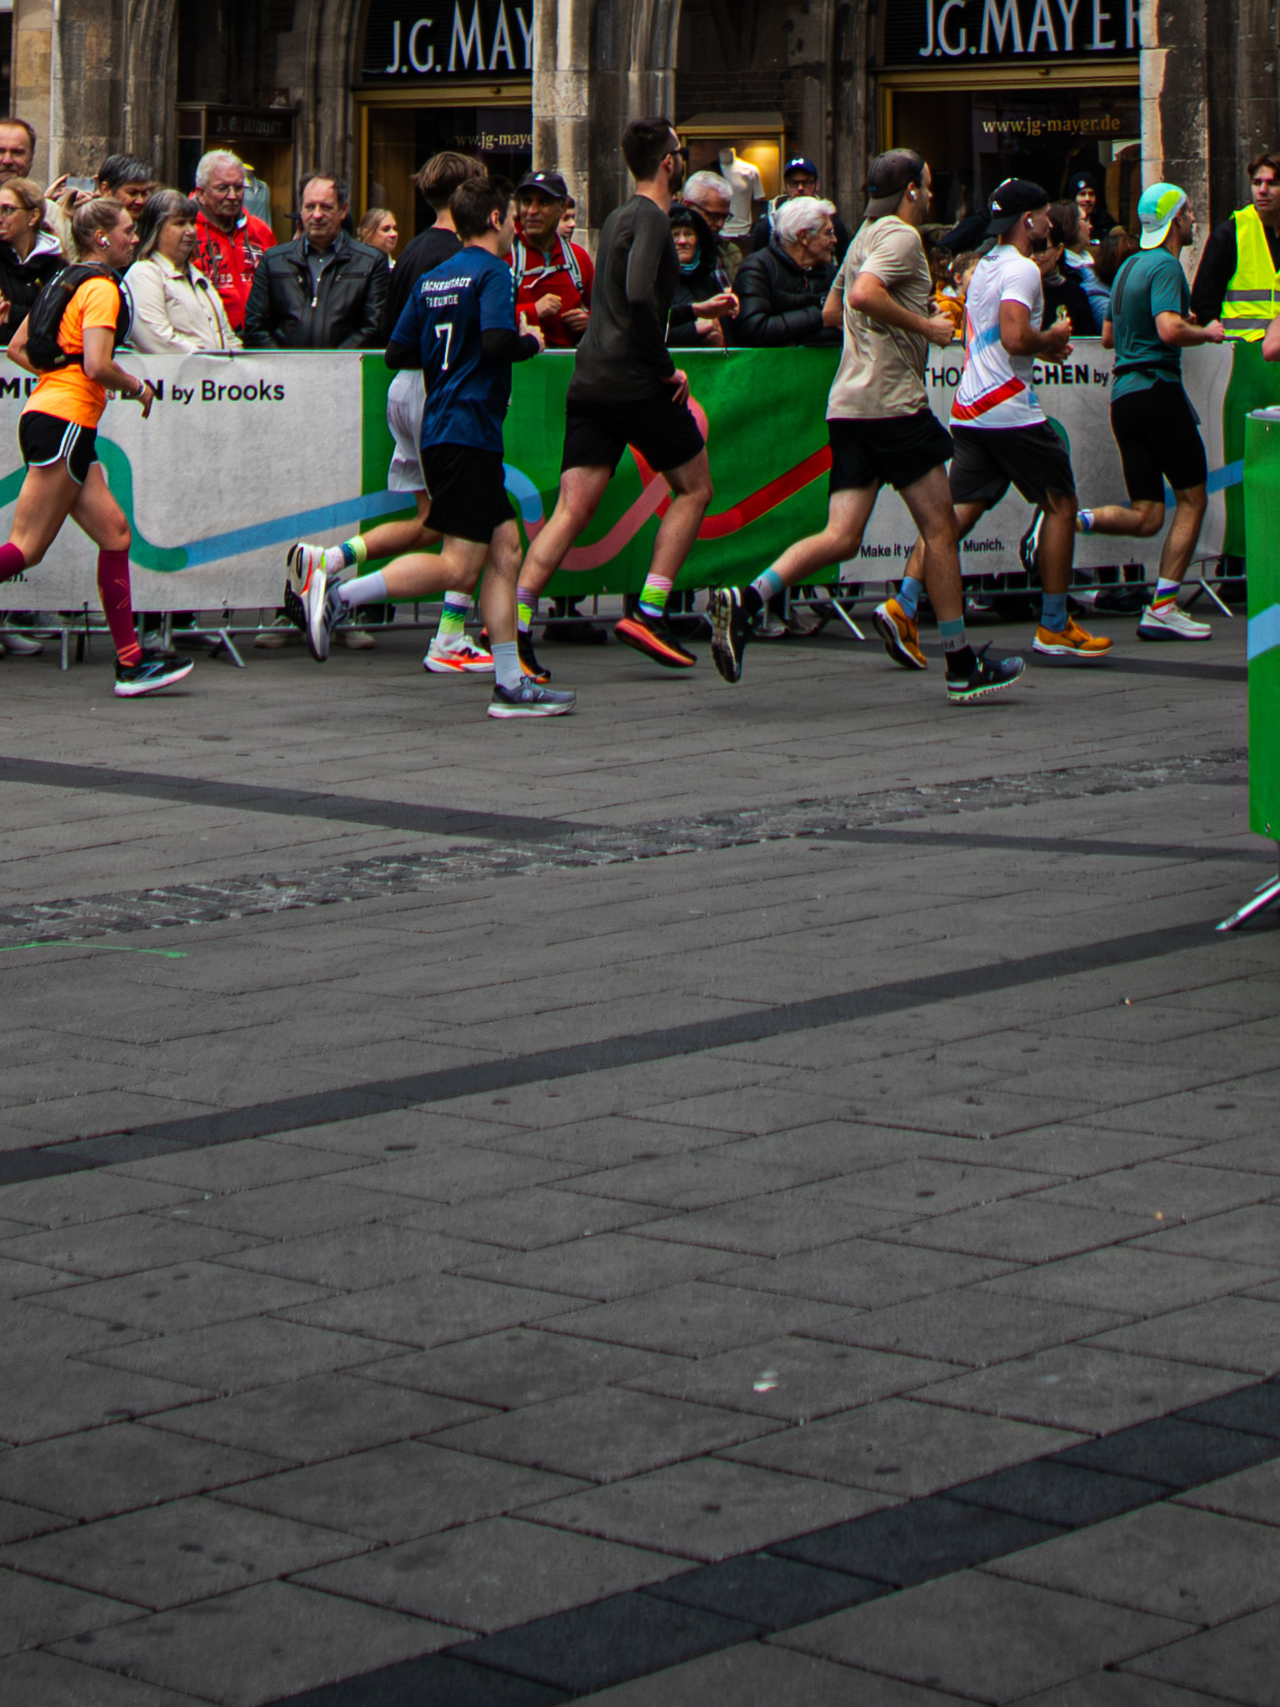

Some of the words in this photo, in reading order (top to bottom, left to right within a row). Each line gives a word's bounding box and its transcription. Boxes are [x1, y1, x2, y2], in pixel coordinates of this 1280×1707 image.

[434, 322, 453, 372] 7
[172, 386, 194, 405] by
[201, 380, 285, 401] Brooks
[860, 544, 891, 559] Make
[893, 543, 902, 557] it
[963, 538, 1005, 553] Munich.
